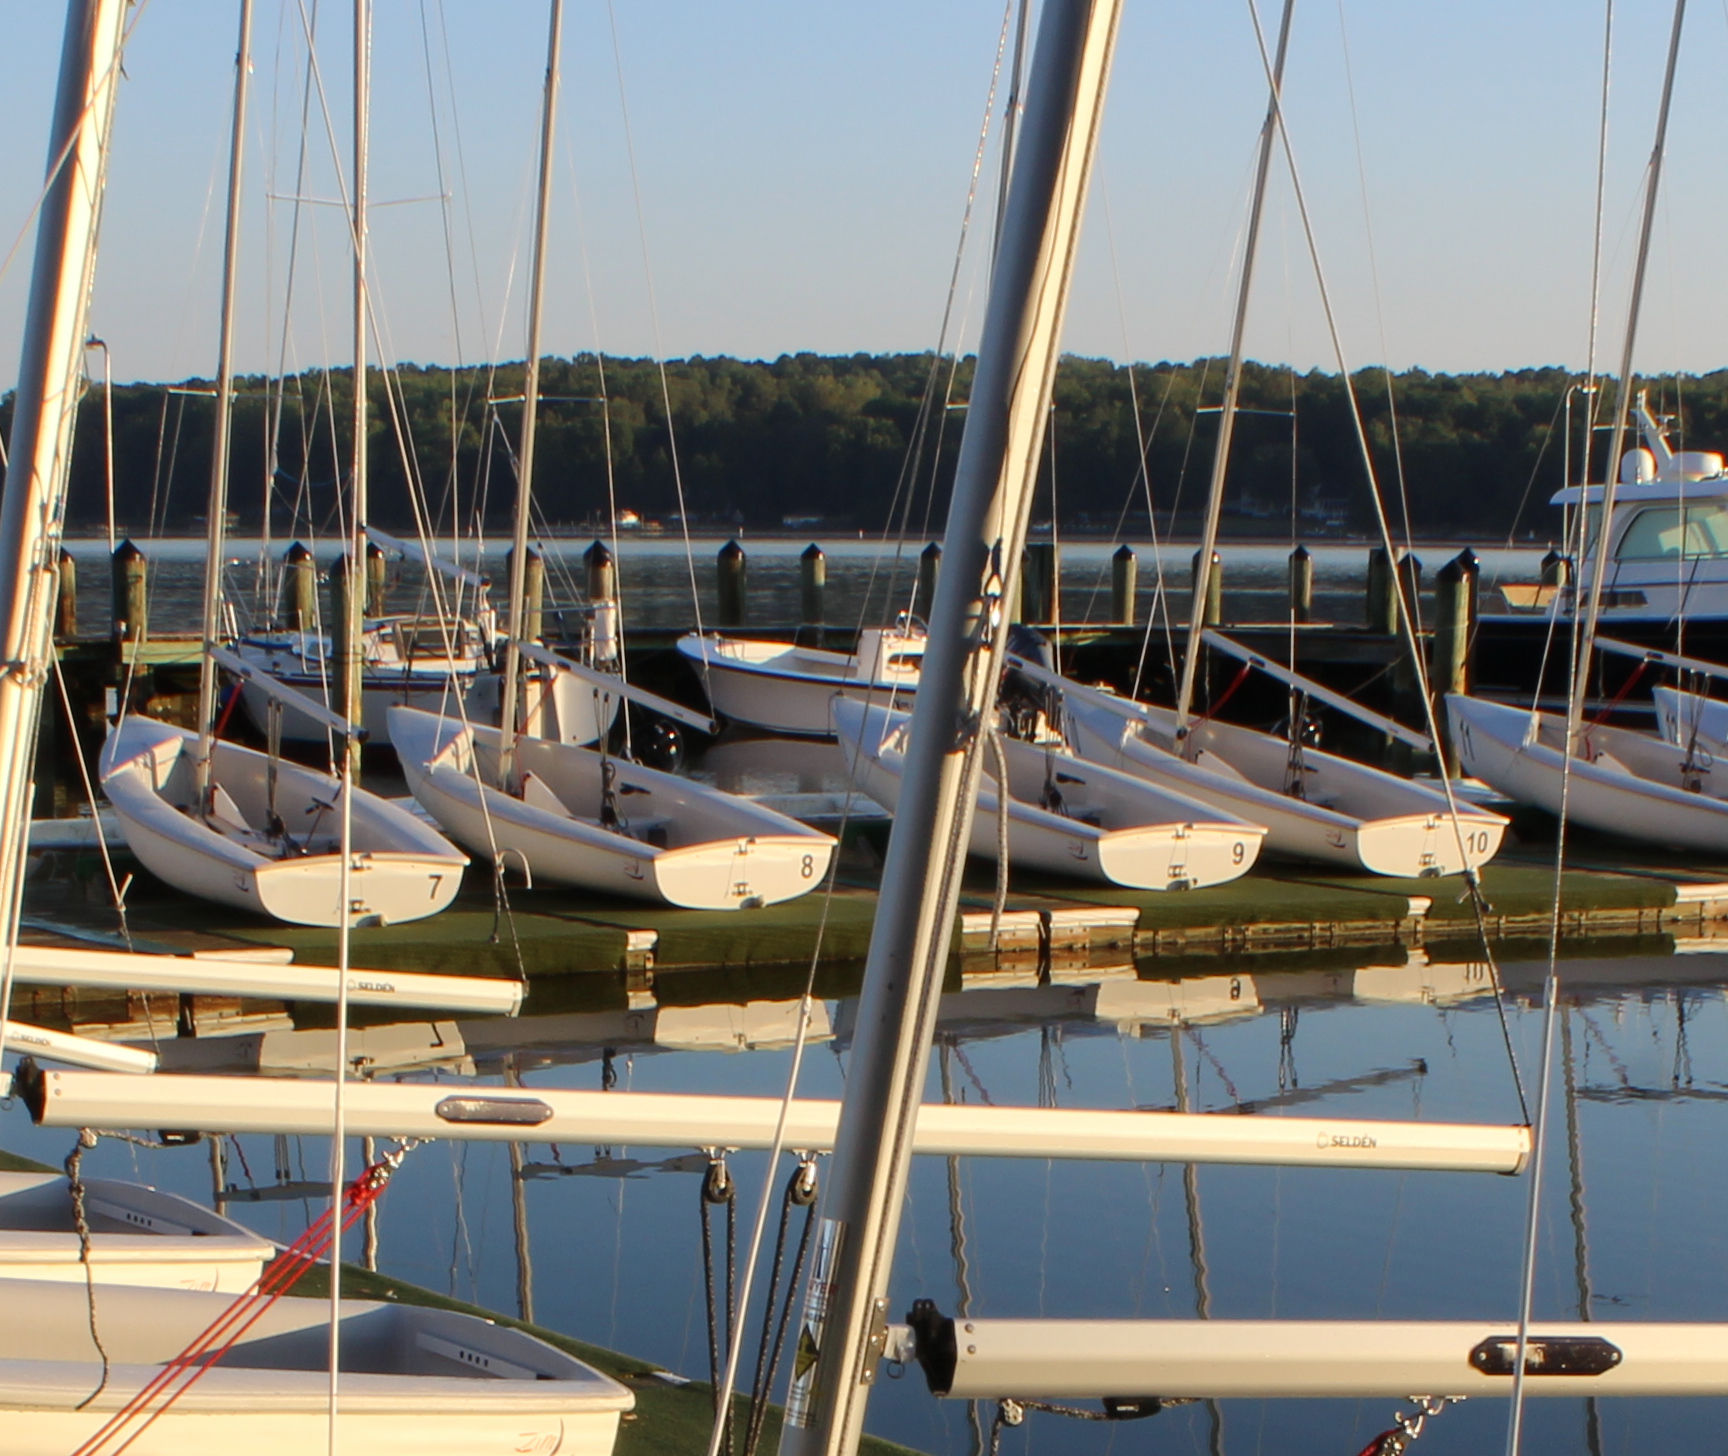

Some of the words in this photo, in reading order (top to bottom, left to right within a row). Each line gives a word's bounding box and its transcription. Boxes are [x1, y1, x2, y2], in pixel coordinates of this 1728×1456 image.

[1232, 842, 1245, 866] 9
[1466, 831, 1488, 854] 10
[801, 853, 814, 879] 8
[428, 874, 443, 900] 7
[1331, 1134, 1377, 1148] SELDÉN
